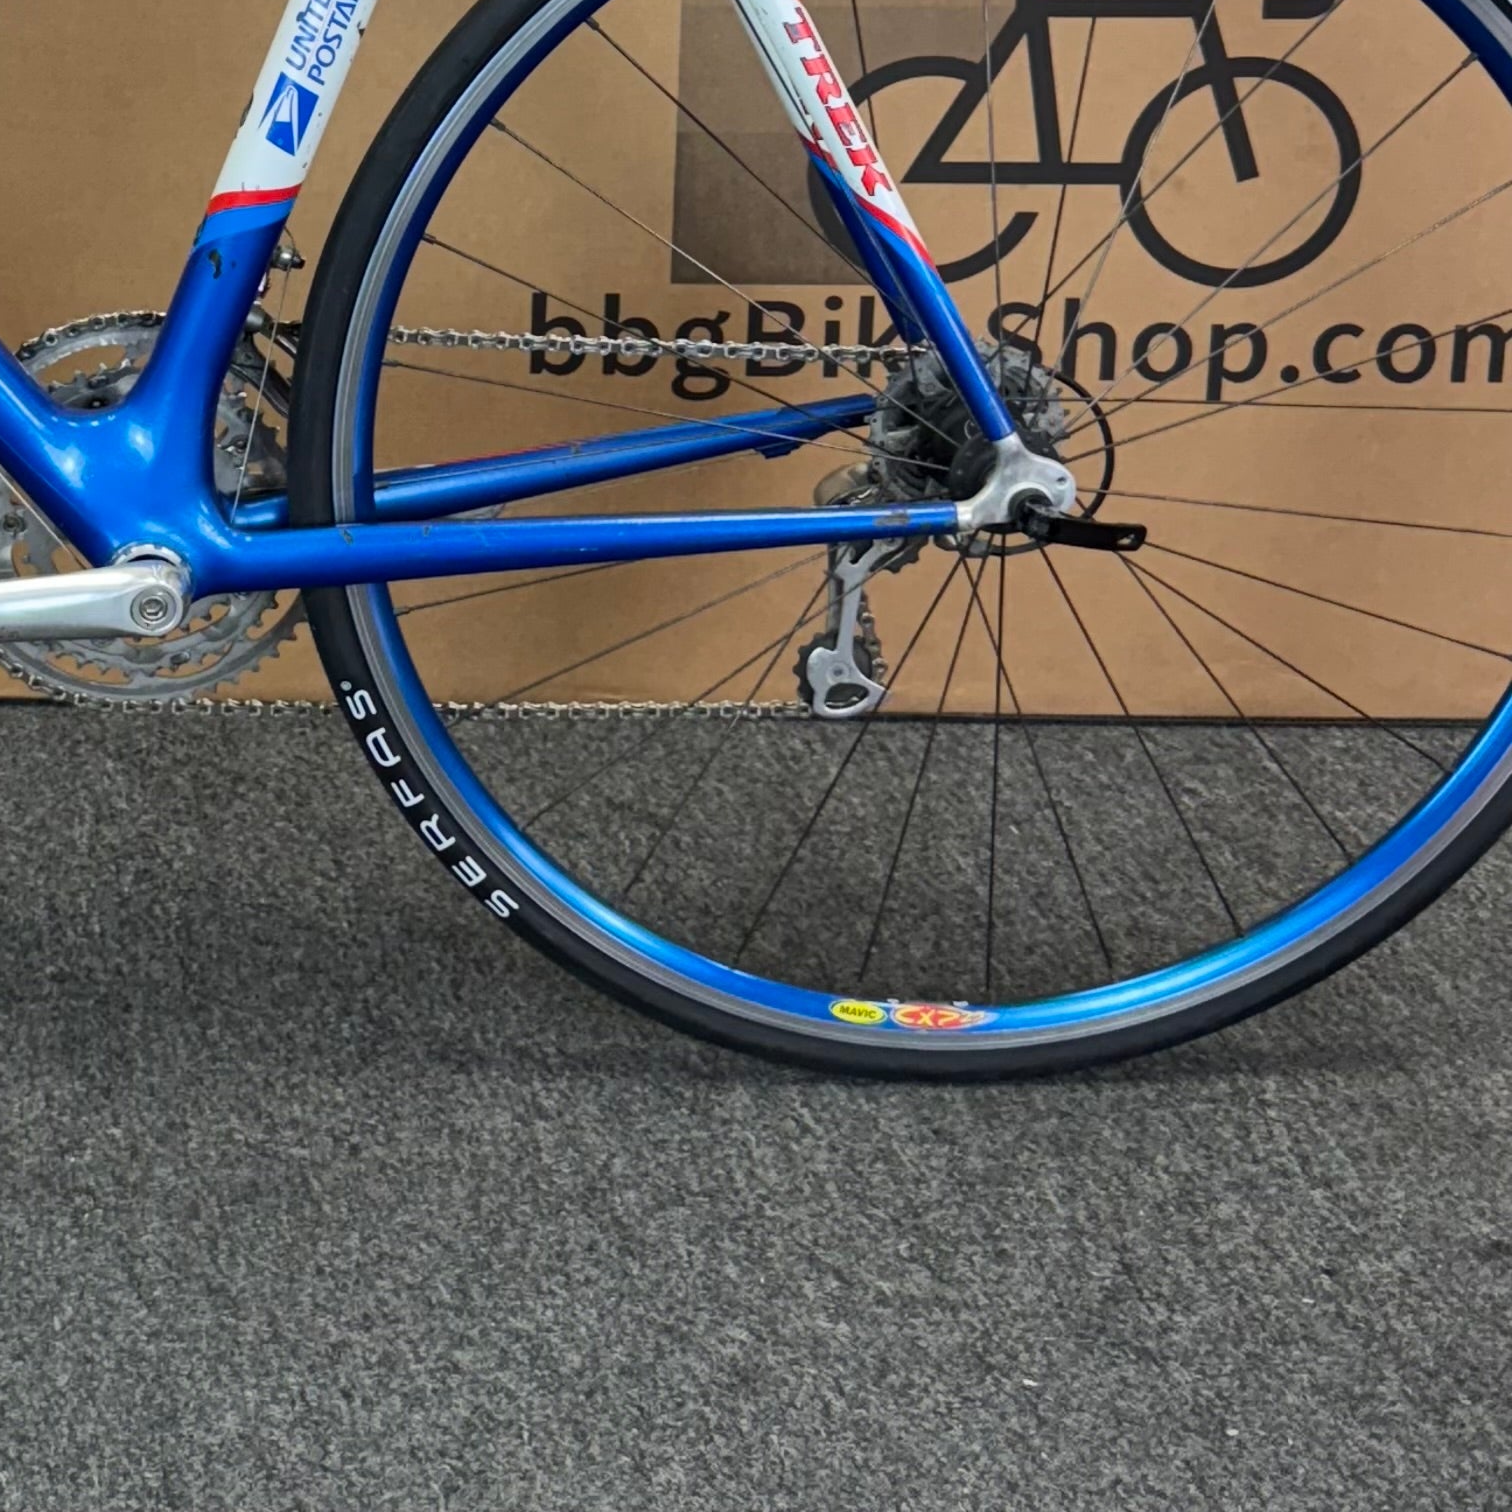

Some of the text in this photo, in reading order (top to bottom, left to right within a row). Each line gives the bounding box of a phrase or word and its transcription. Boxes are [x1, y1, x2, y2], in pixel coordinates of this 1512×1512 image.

[782, 6, 893, 197] TREK
[529, 292, 1512, 402] bbgBikShop.com
[345, 688, 520, 918] SERFAS
[839, 1004, 878, 1020] MAVIC
